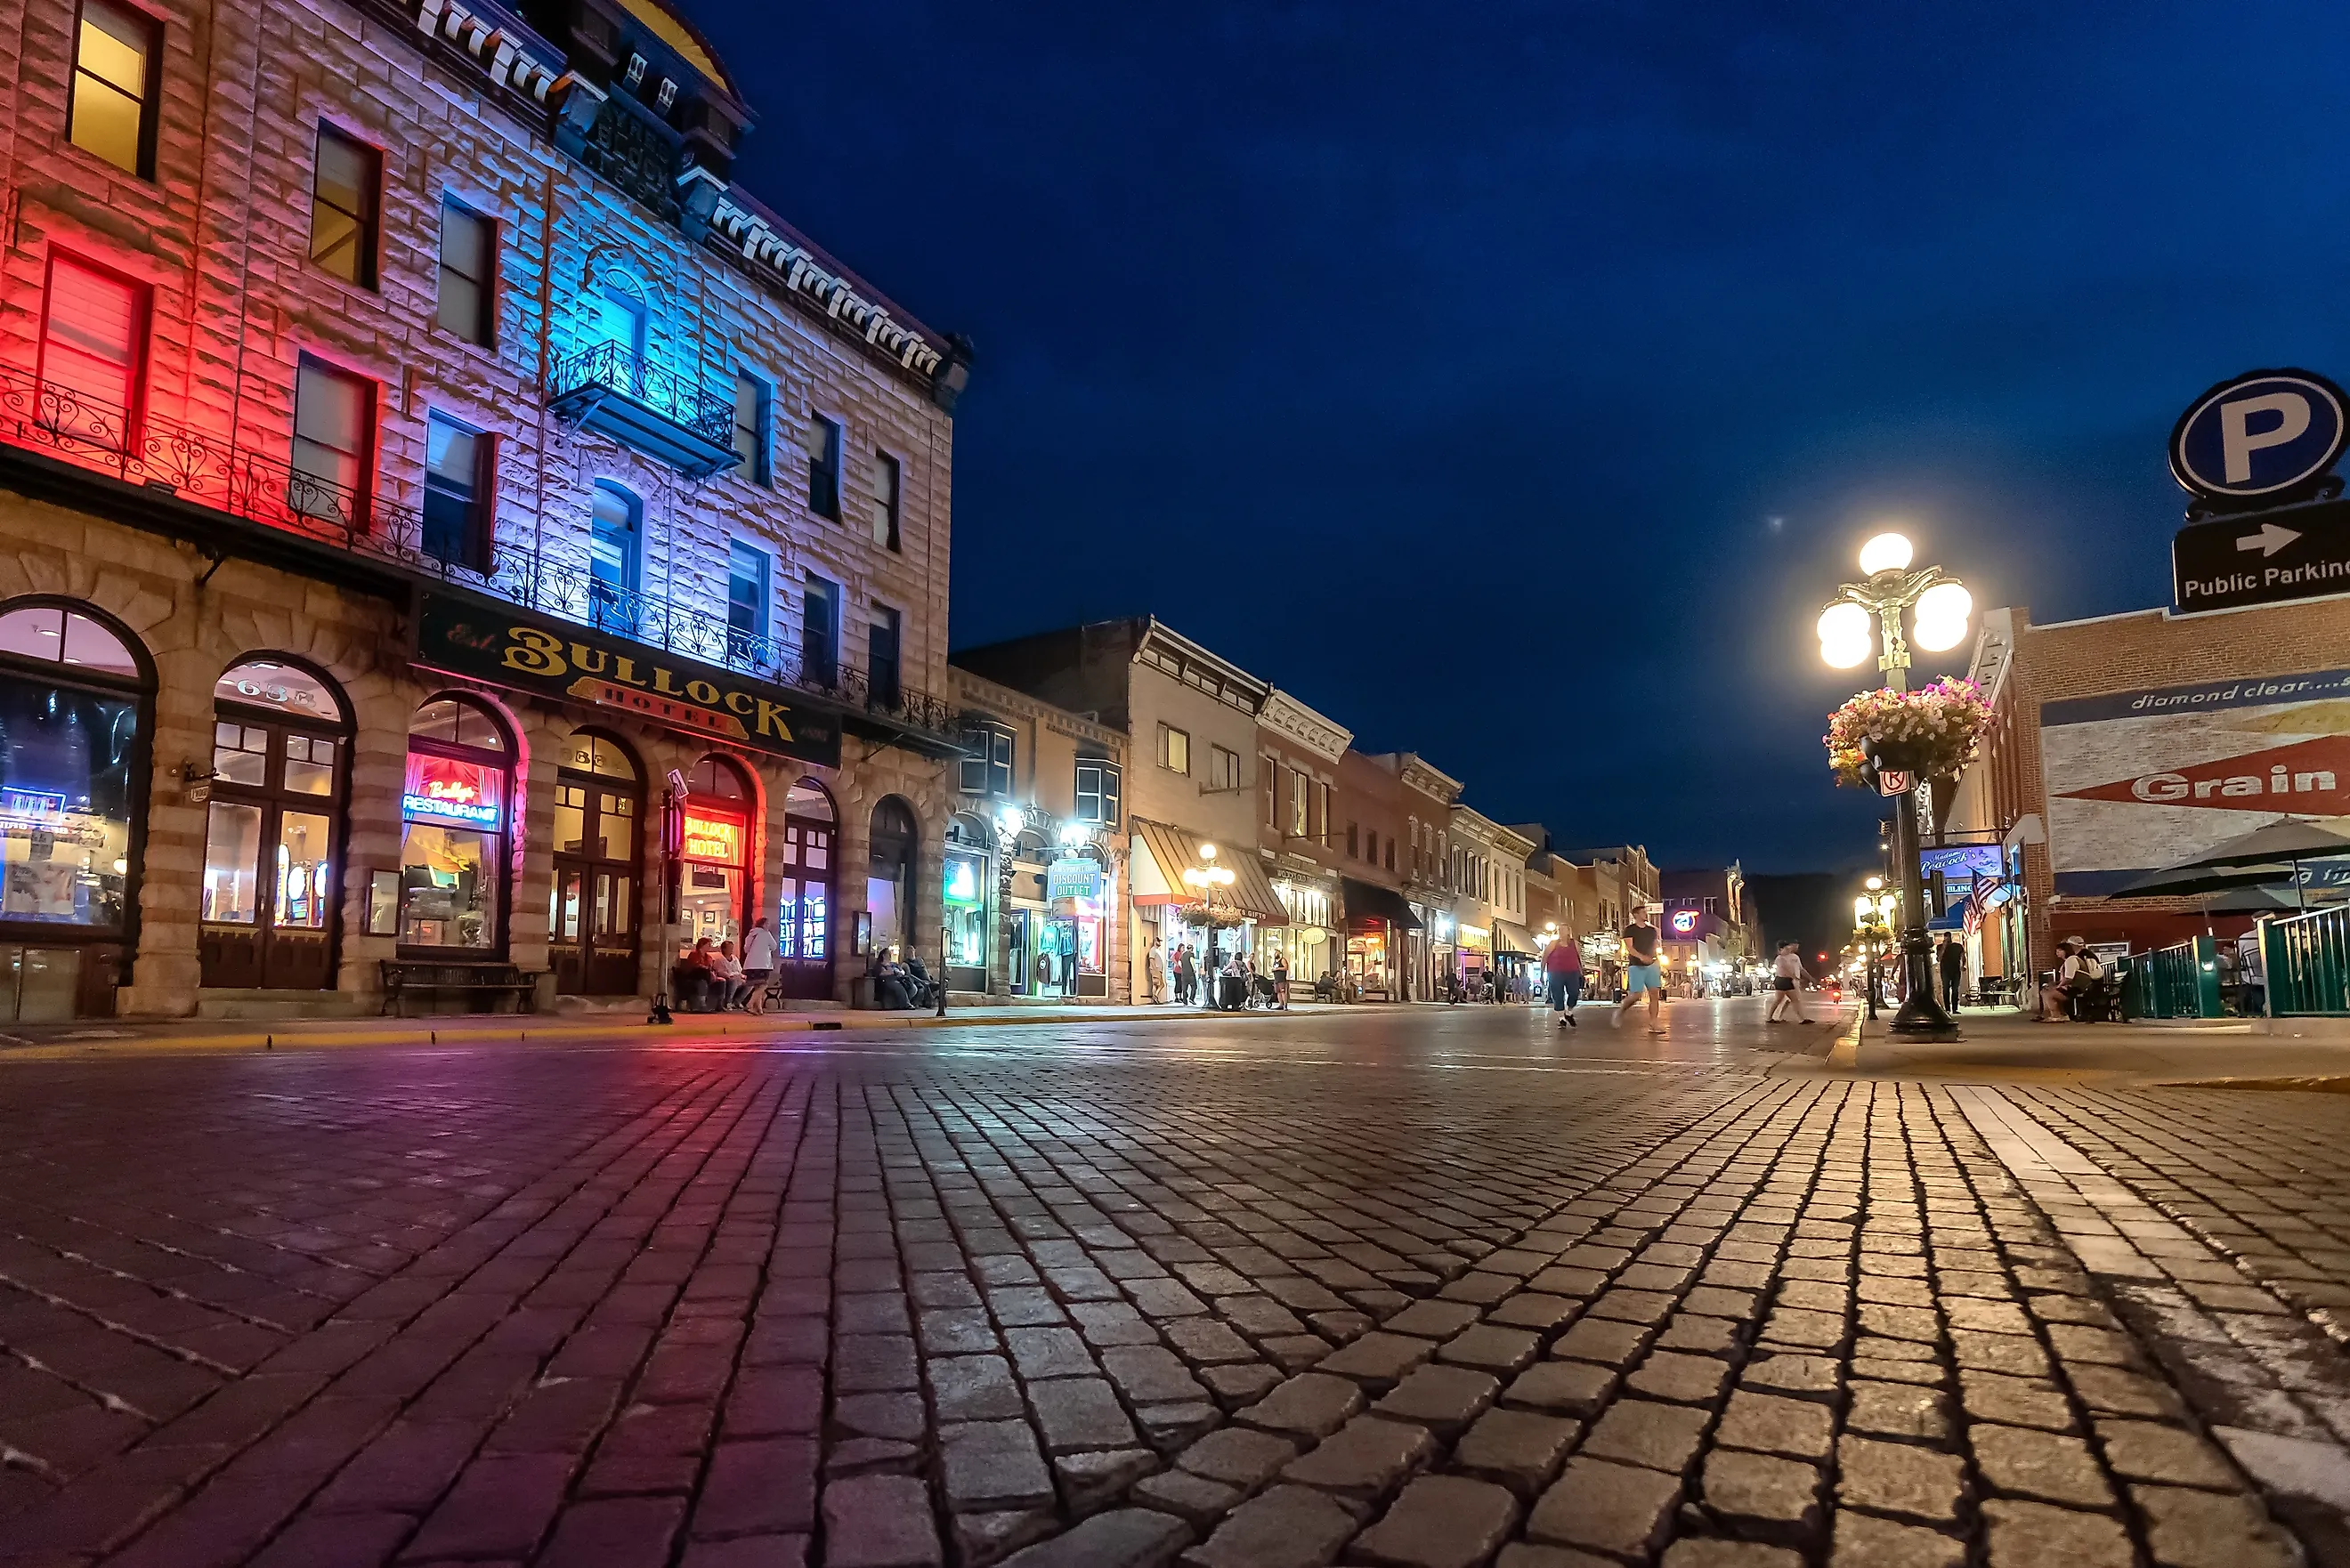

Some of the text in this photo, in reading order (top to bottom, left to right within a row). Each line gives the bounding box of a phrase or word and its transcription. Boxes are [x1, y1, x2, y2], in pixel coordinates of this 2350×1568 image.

[2220, 392, 2311, 484] P
[2184, 572, 2257, 599] Public
[501, 626, 794, 742] BULLOCK
[2131, 684, 2240, 710] diamond
[604, 688, 723, 729] HOTEL
[2131, 764, 2337, 802] Grain
[402, 795, 498, 822] RESTAURANT
[684, 816, 733, 844] BULLOCK
[688, 837, 729, 859] HOTEL
[1053, 873, 1097, 885] DISCOUNT
[1057, 885, 1090, 896] OUTLET
[1248, 910, 1268, 921] GIFTS
